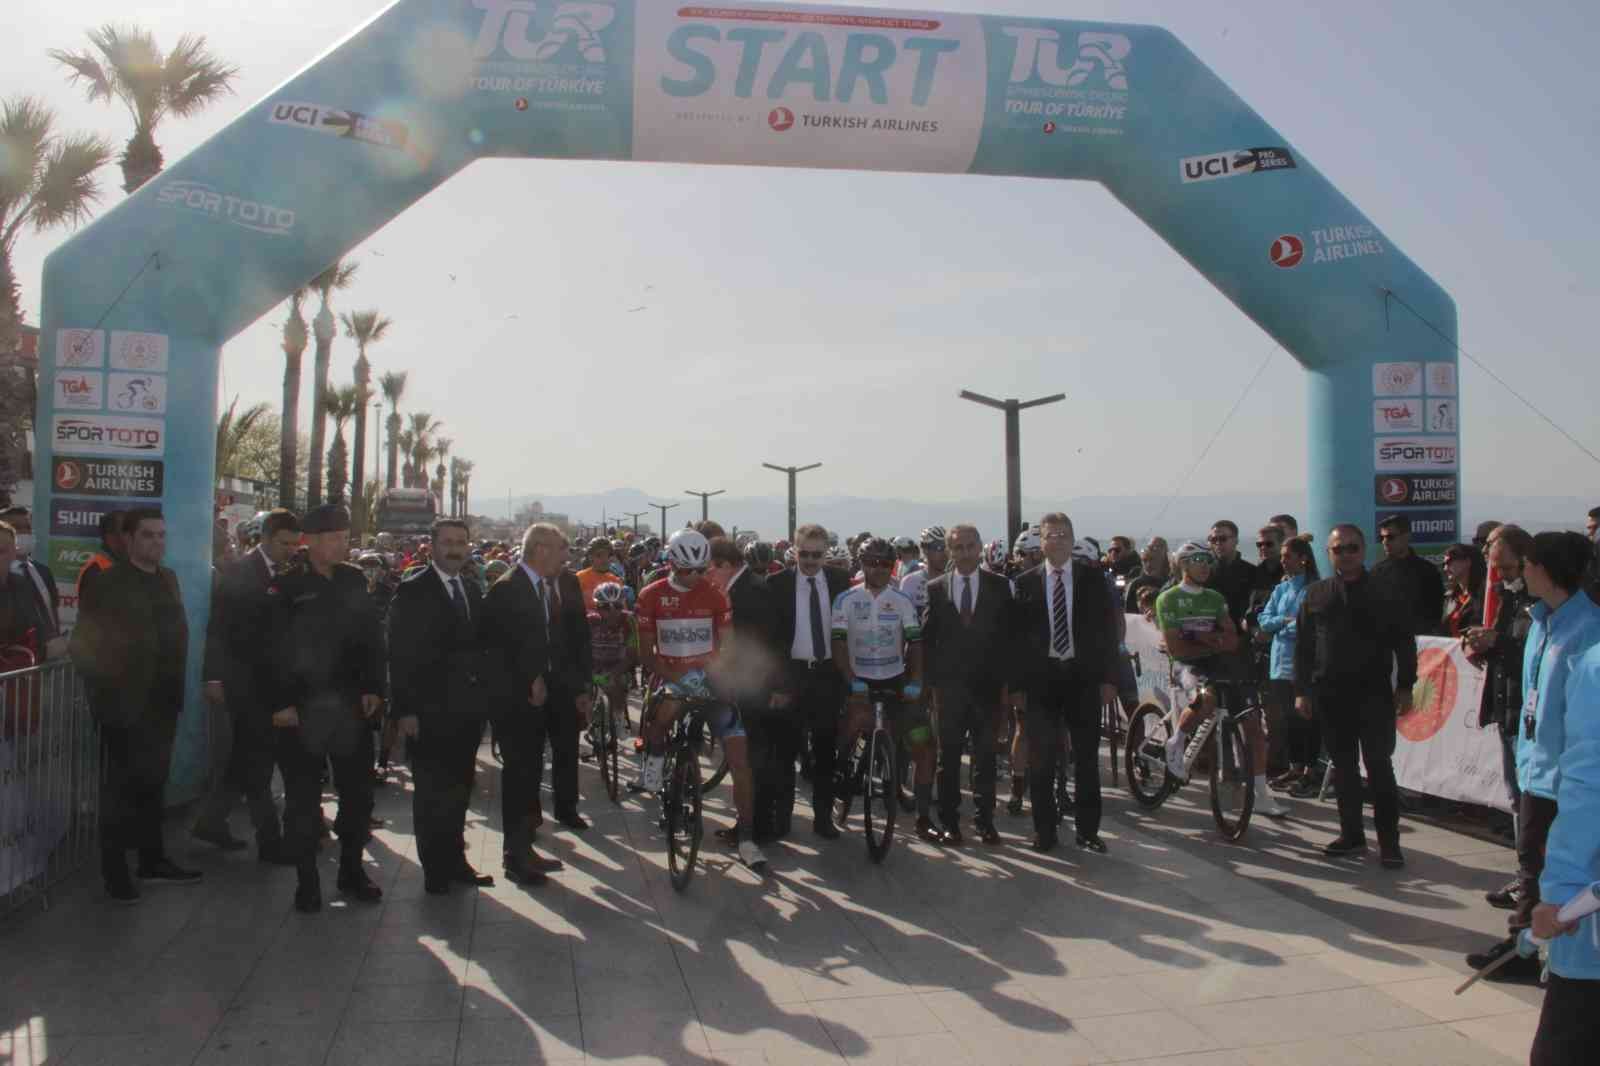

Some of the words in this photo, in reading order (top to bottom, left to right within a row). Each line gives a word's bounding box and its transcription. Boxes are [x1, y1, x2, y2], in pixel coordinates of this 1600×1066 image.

[659, 23, 961, 107] START
[274, 104, 319, 126] UCI
[1005, 100, 1042, 115] TOUR
[1045, 102, 1065, 115] OF
[802, 114, 868, 130] TURKISH
[872, 116, 938, 132] AIRLINES
[1185, 157, 1229, 180] UCI
[57, 426, 159, 444] SPORTOTO
[85, 463, 154, 478] TURKISH
[84, 477, 155, 491] AIRLINES
